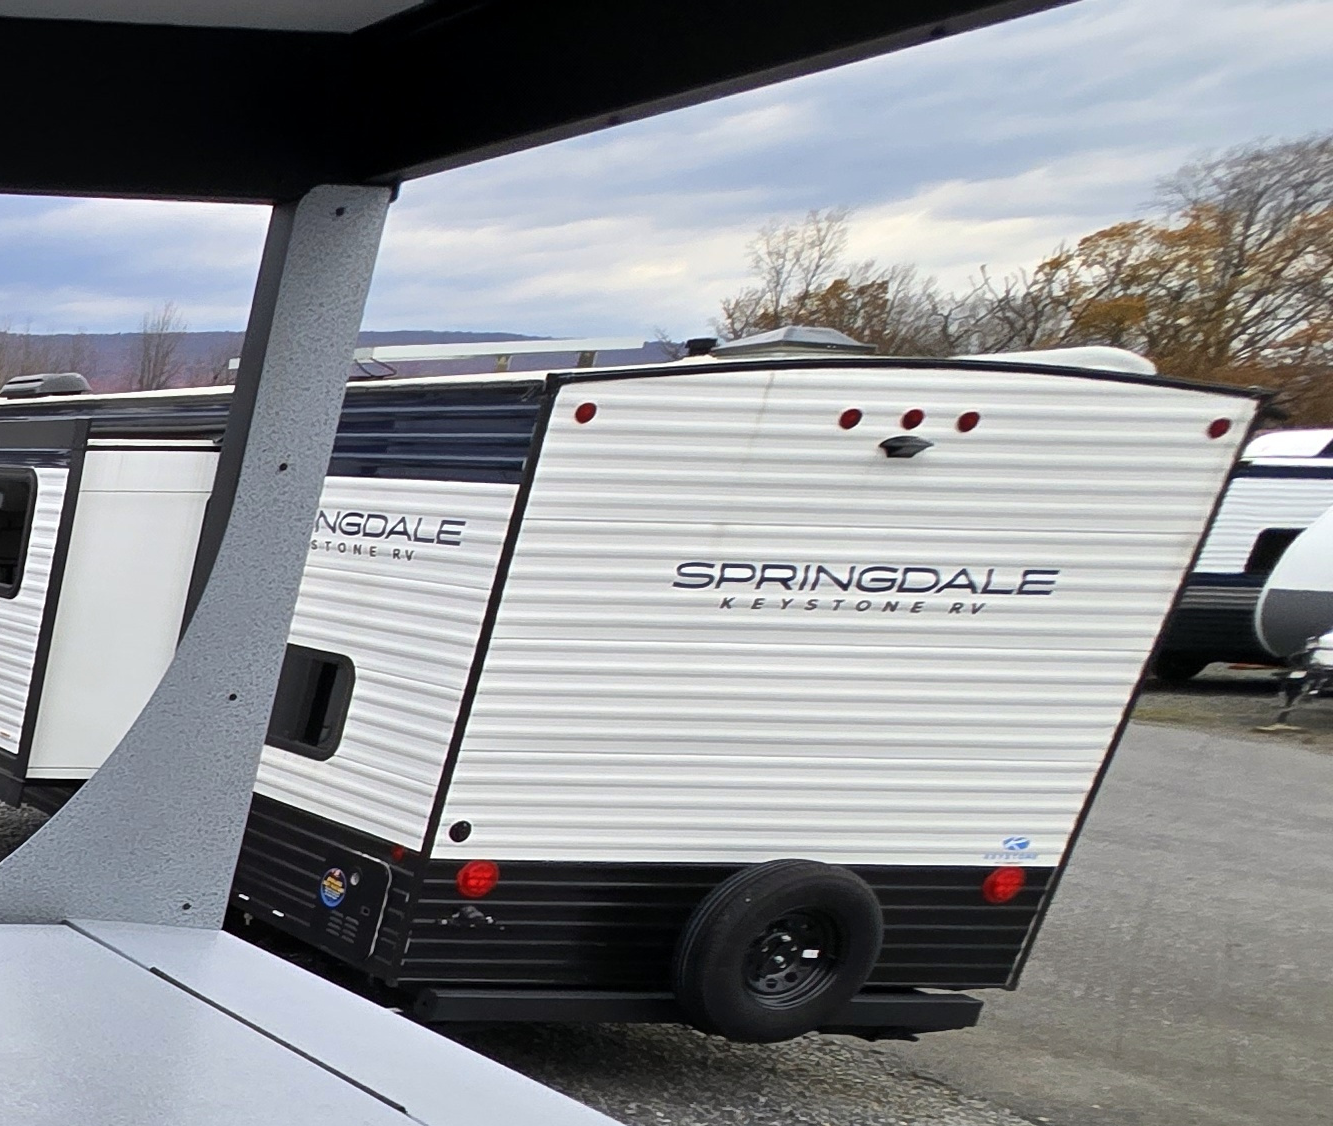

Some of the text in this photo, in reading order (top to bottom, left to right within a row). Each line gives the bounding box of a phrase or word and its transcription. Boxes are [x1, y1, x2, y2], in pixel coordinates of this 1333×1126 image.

[314, 510, 467, 547] NGDALE
[310, 538, 415, 562] STONE RV
[671, 562, 1061, 596] SPRINGDALE
[719, 596, 987, 616] KEYSTONE RV
